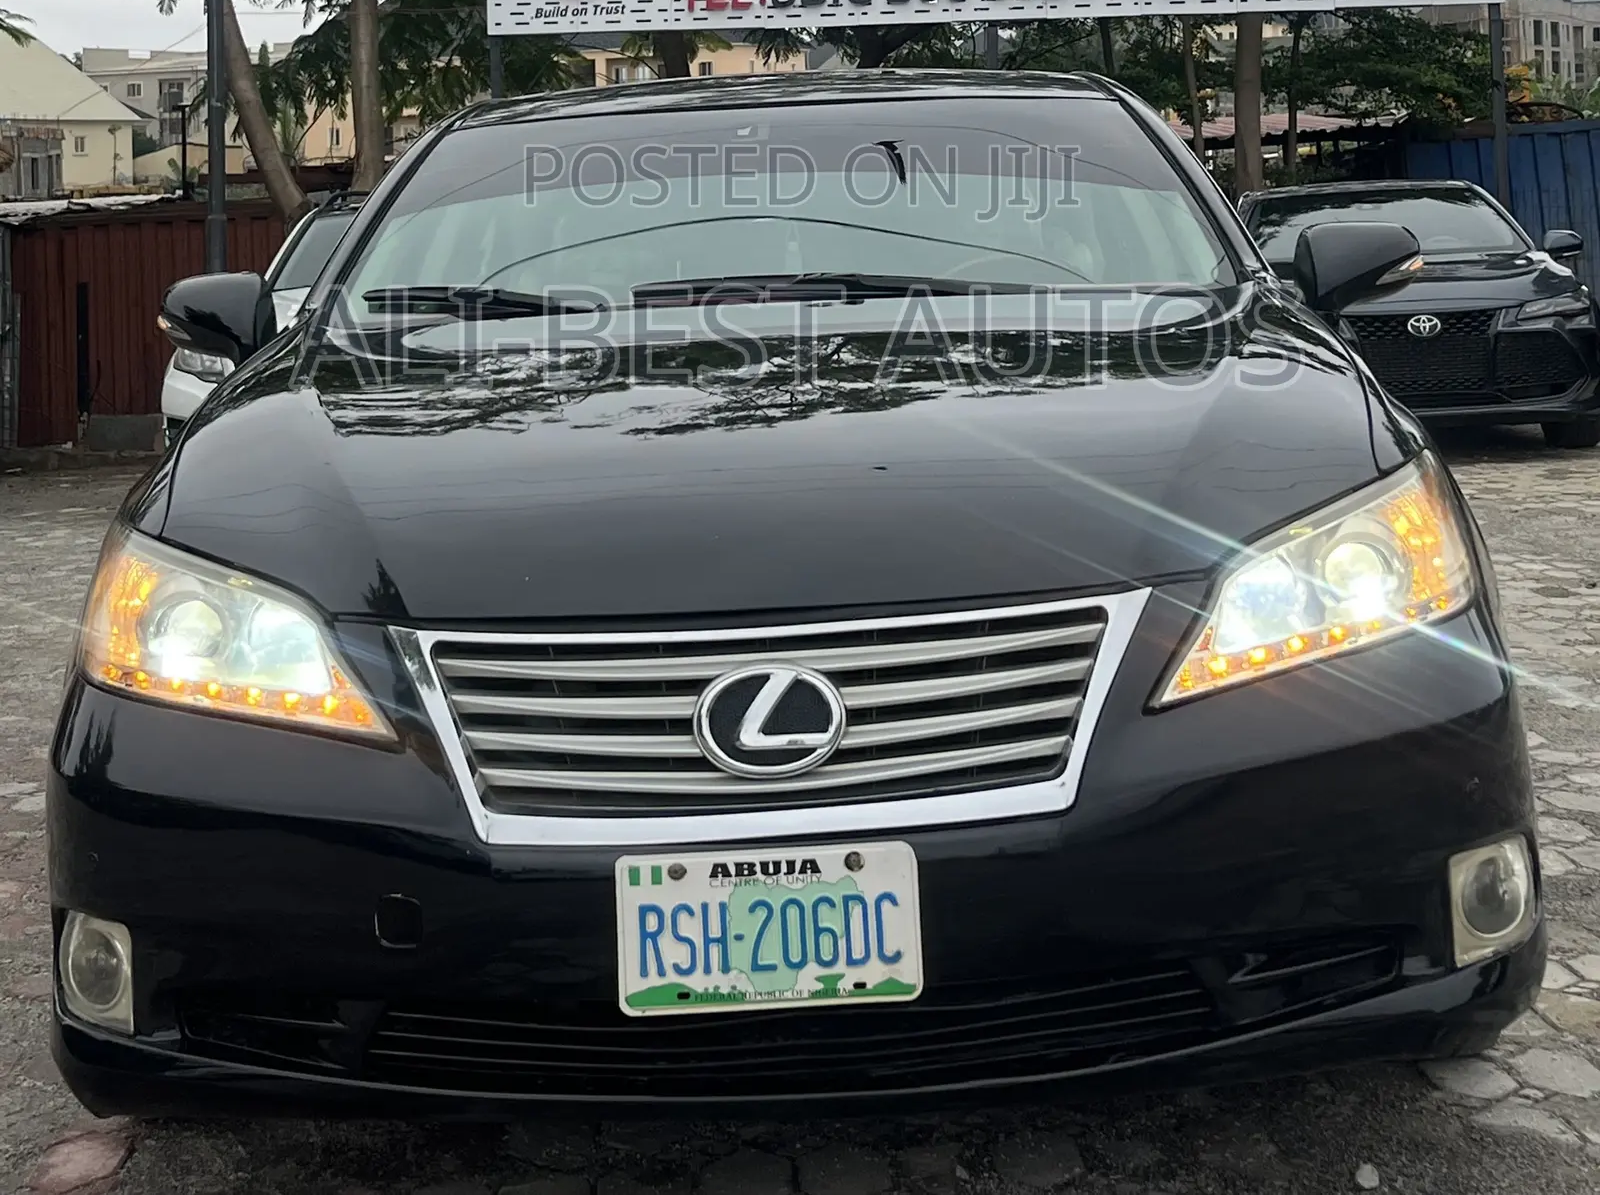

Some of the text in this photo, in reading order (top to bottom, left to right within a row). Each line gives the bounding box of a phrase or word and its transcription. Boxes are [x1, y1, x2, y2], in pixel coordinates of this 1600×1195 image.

[534, 4, 626, 19] Build on Trust
[709, 858, 822, 878] ABUJA
[709, 874, 822, 888] CENTRE OF UNITY
[638, 891, 904, 978] RSH-206DC
